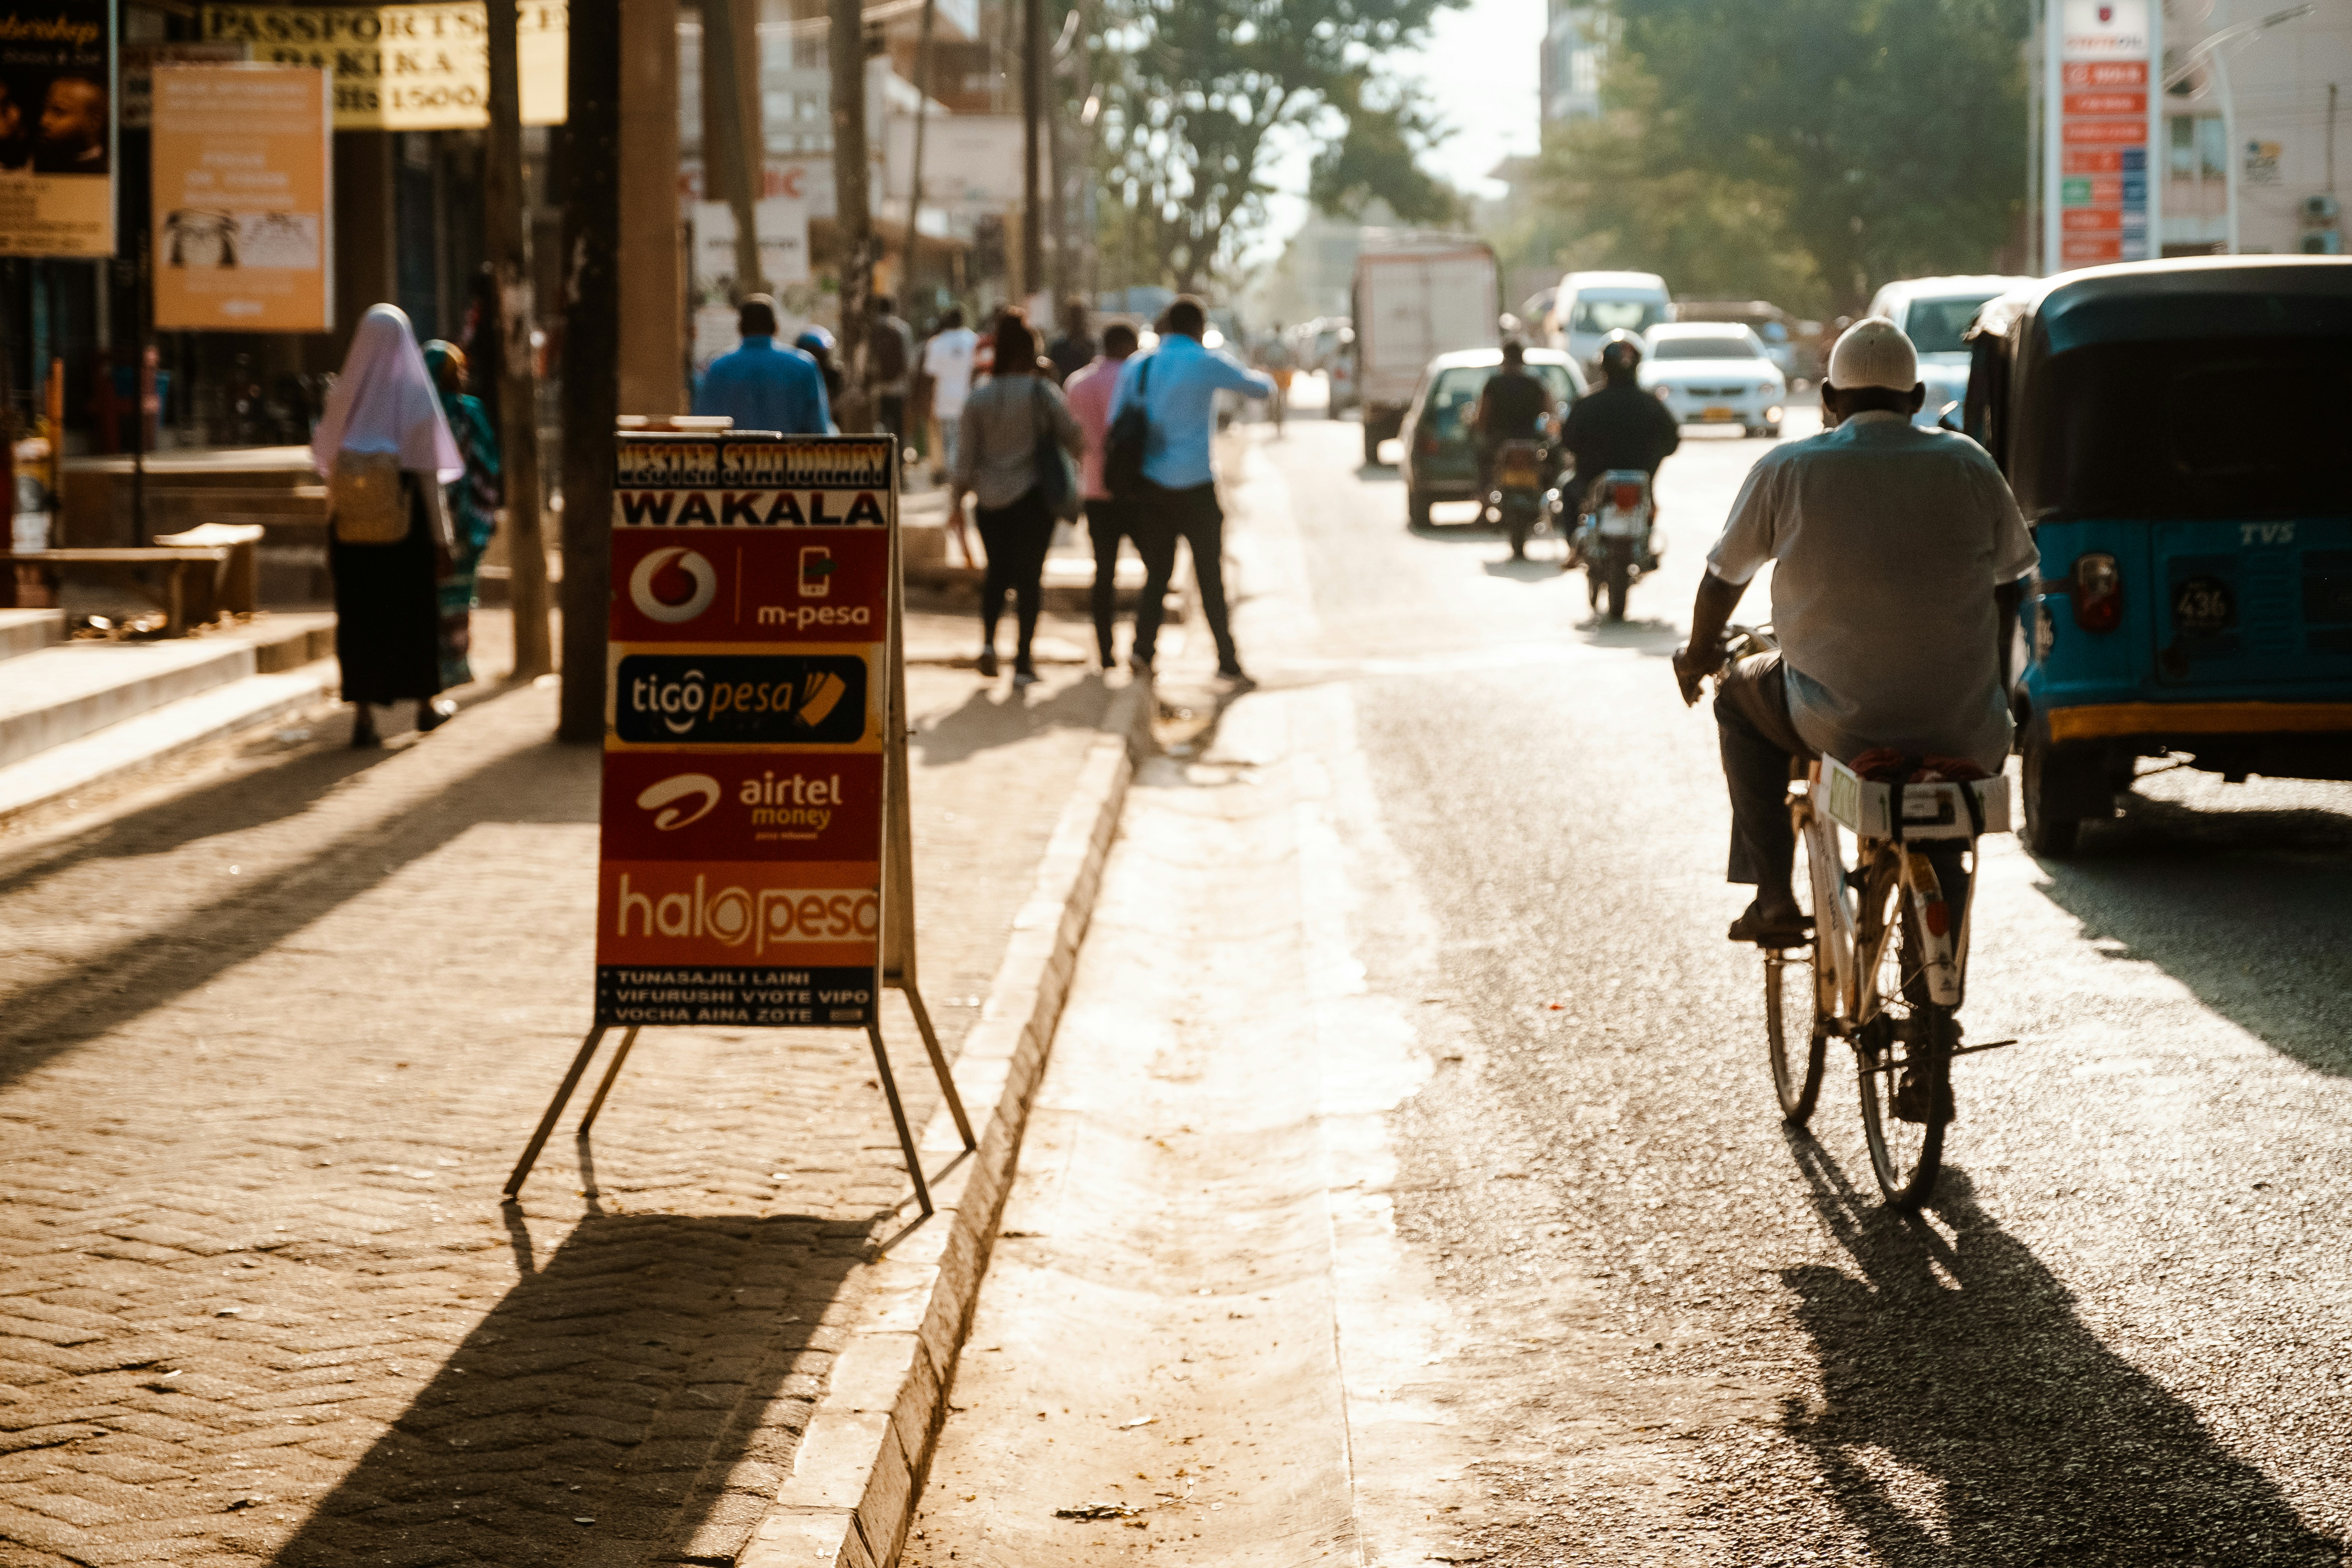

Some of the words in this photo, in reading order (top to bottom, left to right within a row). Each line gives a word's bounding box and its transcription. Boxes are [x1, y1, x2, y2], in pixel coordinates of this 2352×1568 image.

[721, 443, 888, 487] STATIONARY
[620, 491, 884, 525] WAKALA
[2239, 521, 2296, 546] TVS
[757, 605, 871, 631] m-pesa
[707, 681, 794, 722] pesa
[738, 770, 843, 805] airtel
[752, 807, 831, 830] money
[616, 971, 746, 986] TUNASAJILI
[753, 971, 810, 986] LAINI
[616, 989, 735, 1004] VIFURUSHI
[740, 989, 812, 1004] VYOTE
[818, 990, 870, 1004] VIPO
[615, 1008, 690, 1022] VOCHA
[695, 1008, 750, 1022] AINA
[756, 1008, 812, 1023] ZOTE
